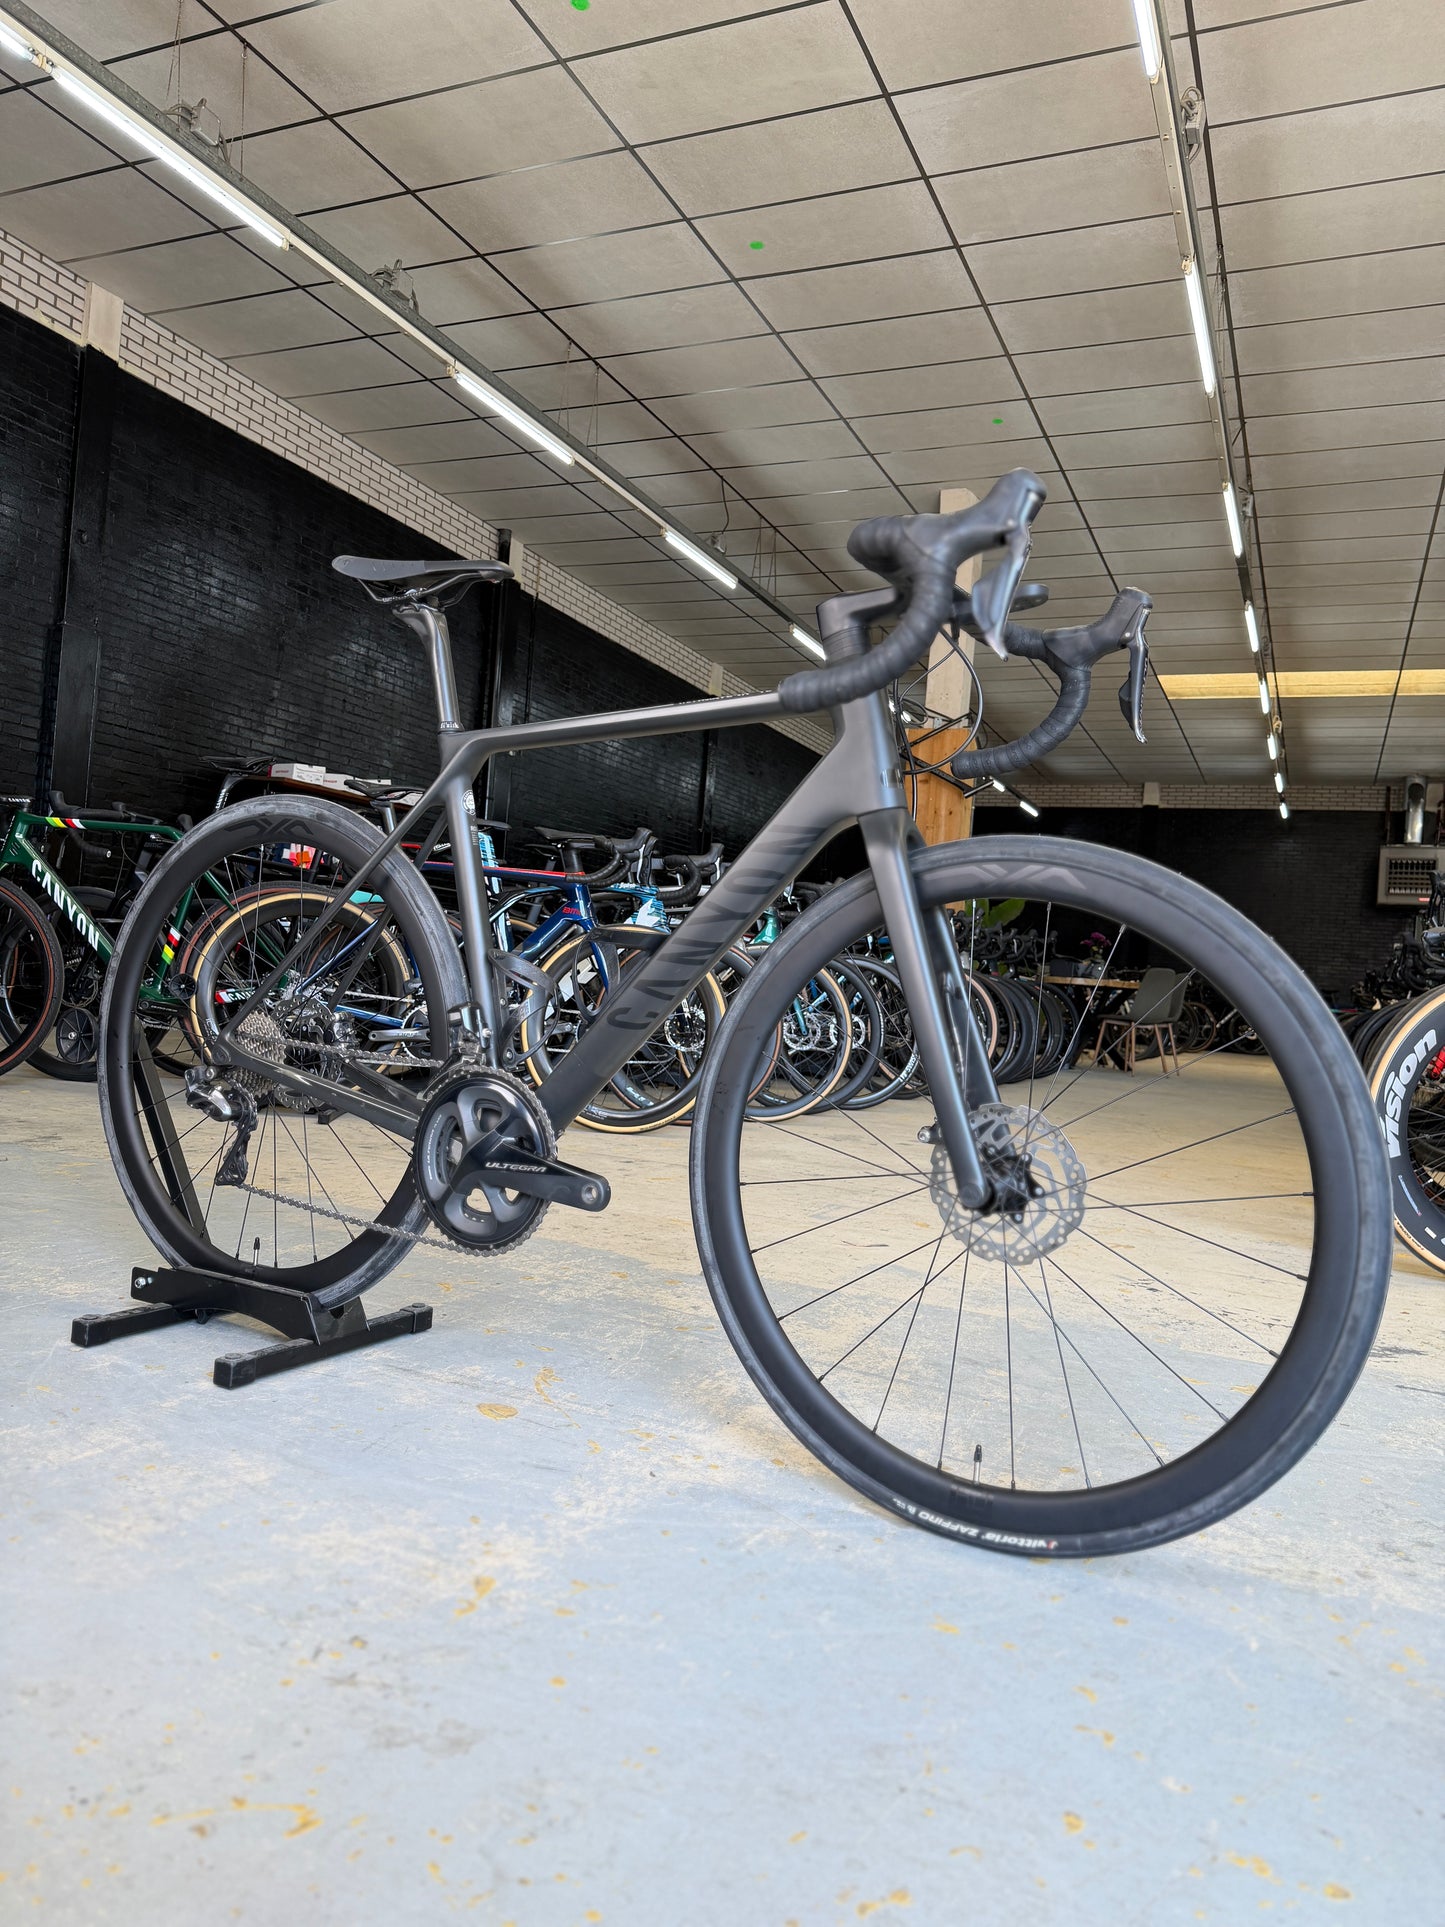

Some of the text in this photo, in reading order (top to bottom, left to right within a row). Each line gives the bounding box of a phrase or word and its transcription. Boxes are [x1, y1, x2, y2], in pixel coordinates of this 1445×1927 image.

[32, 860, 99, 951] CANYON
[607, 825, 827, 1030] CANYON
[1379, 1029, 1437, 1158] vision
[485, 1161, 547, 1173] ULTEGRA
[918, 1512, 1047, 1549] vittoria ZAFFIRO
